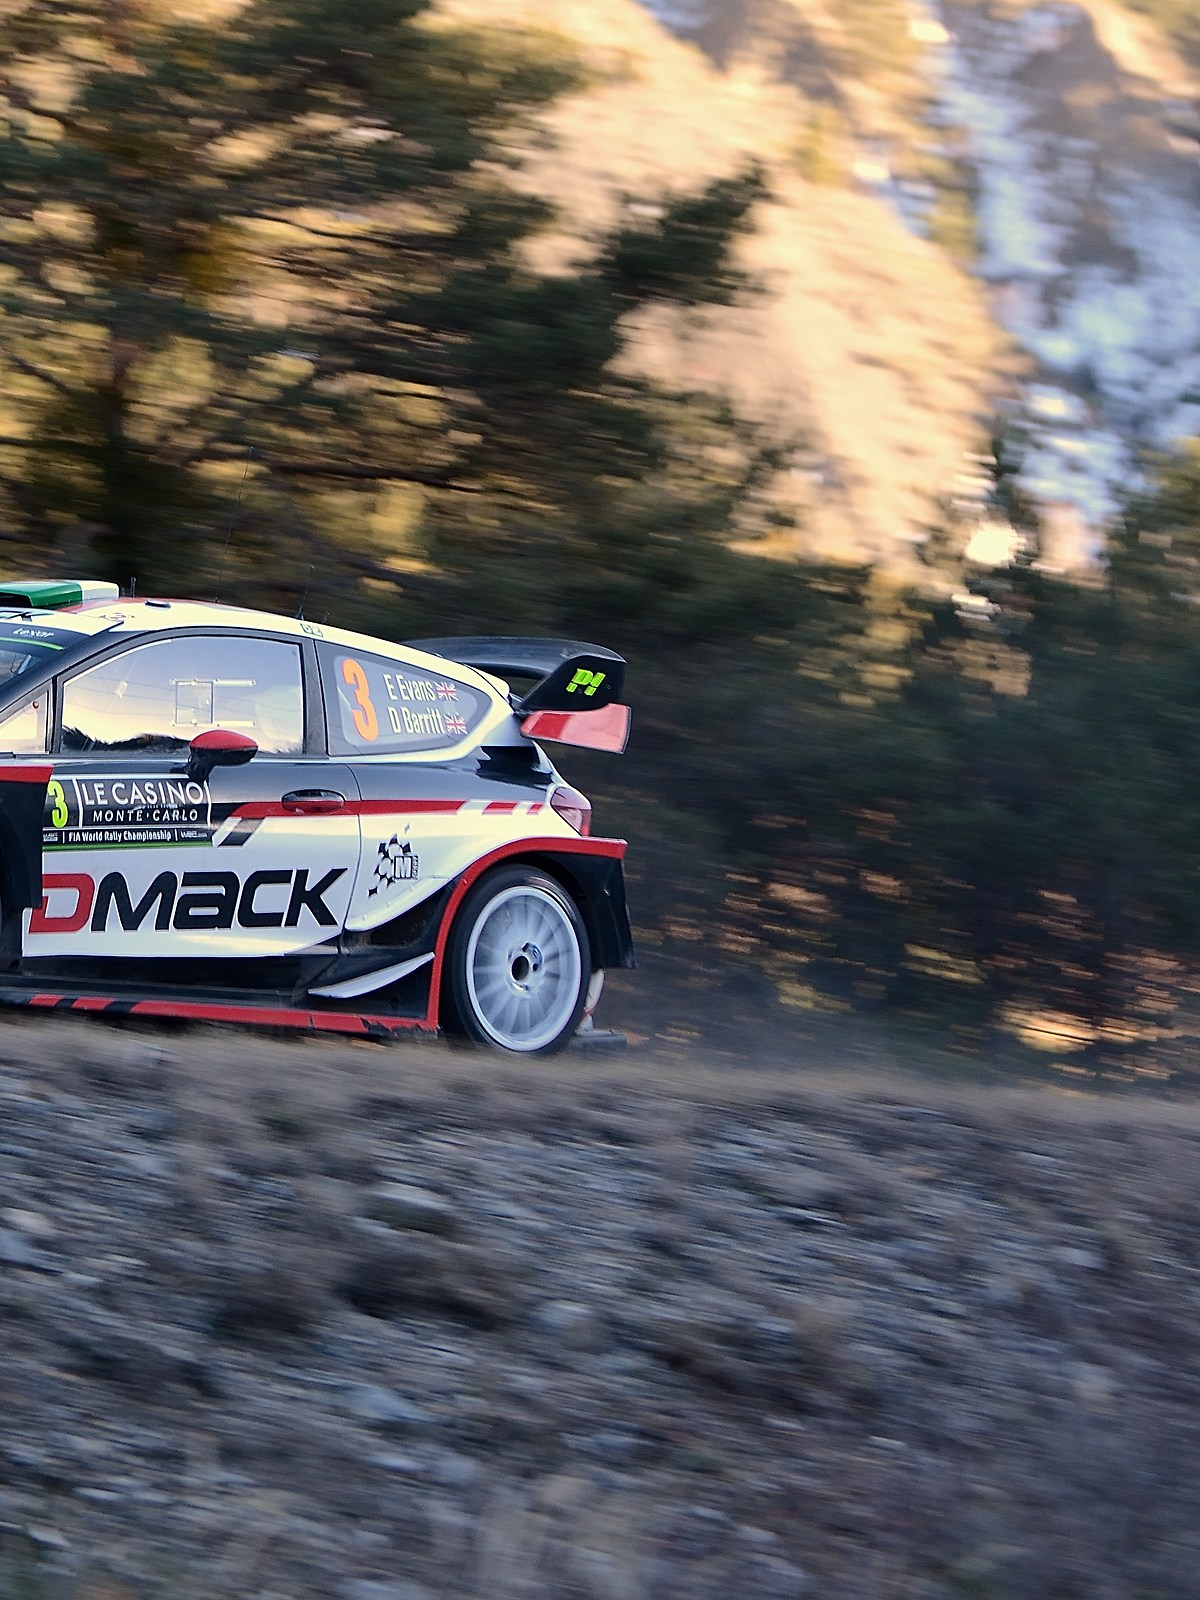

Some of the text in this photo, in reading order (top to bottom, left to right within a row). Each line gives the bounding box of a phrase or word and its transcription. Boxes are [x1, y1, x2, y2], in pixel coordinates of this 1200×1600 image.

[342, 658, 379, 742] 3
[383, 674, 436, 701] E Evans
[387, 707, 446, 735] D Barritt
[47, 780, 69, 828] 3
[81, 781, 204, 806] LE CASINO
[93, 808, 198, 823] MONTE CARLO
[68, 831, 81, 842] FIA
[81, 831, 103, 842] World
[104, 830, 122, 843] Rally
[123, 829, 172, 843] Championship
